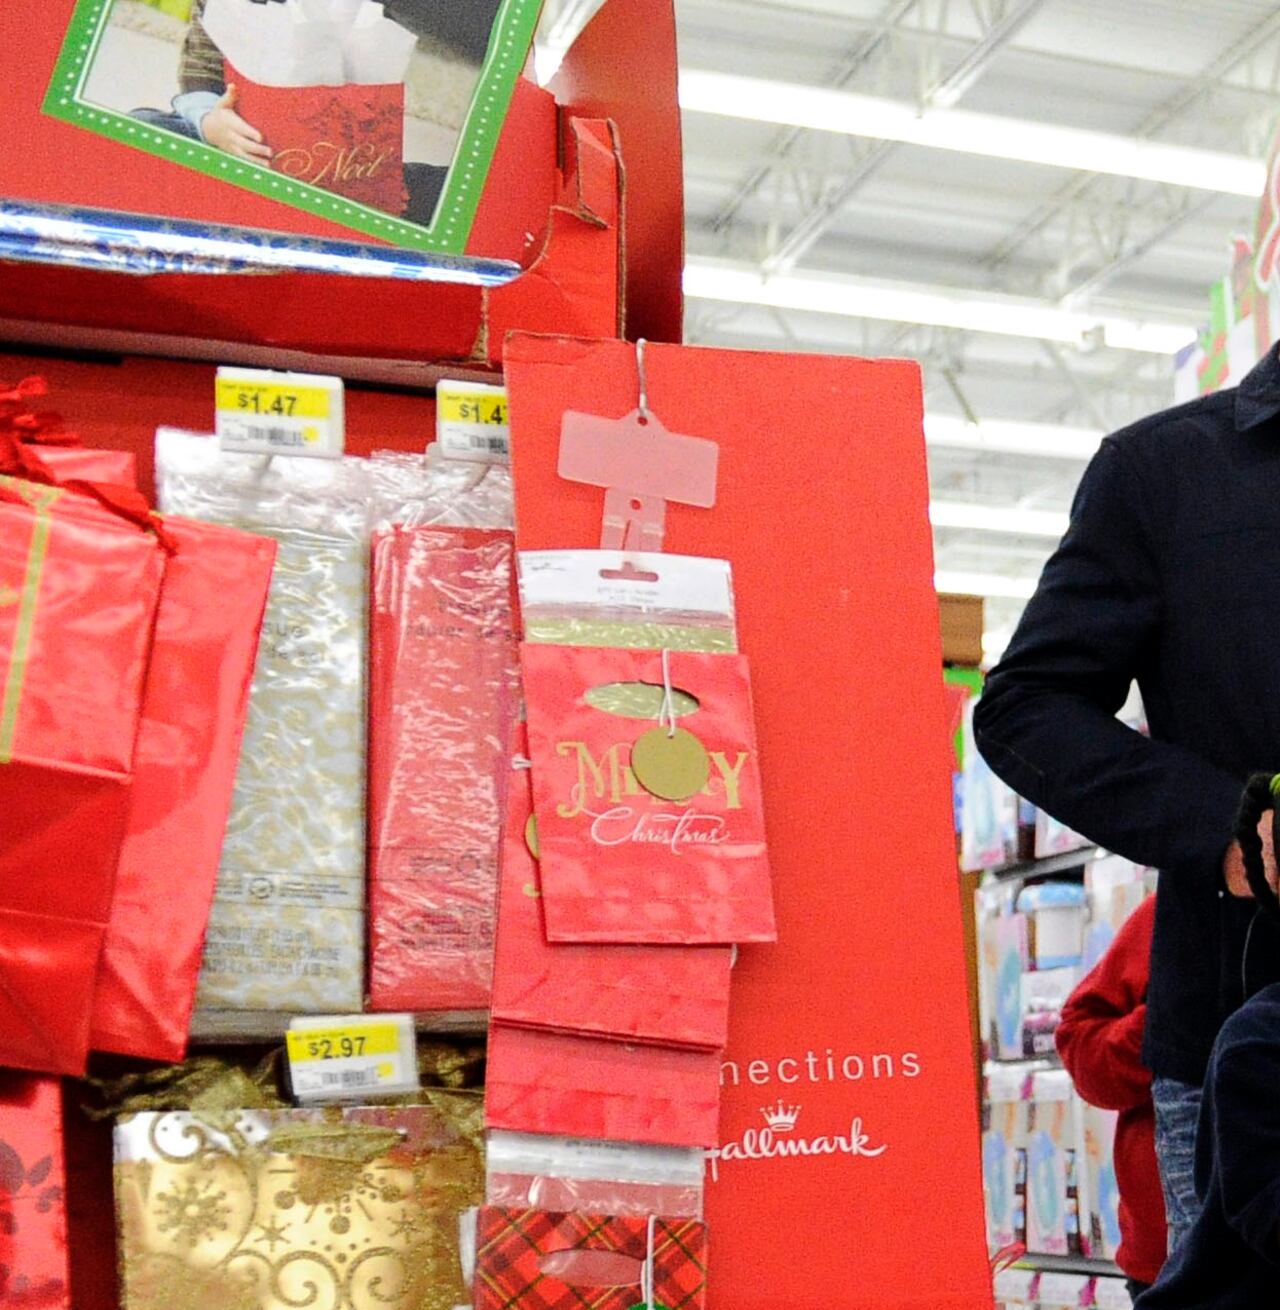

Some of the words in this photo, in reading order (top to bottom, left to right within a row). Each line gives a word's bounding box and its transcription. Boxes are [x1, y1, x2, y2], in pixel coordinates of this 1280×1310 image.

[237, 394, 297, 416] $1.47
[588, 807, 731, 855] Christmas
[308, 1036, 366, 1060] $2.97
